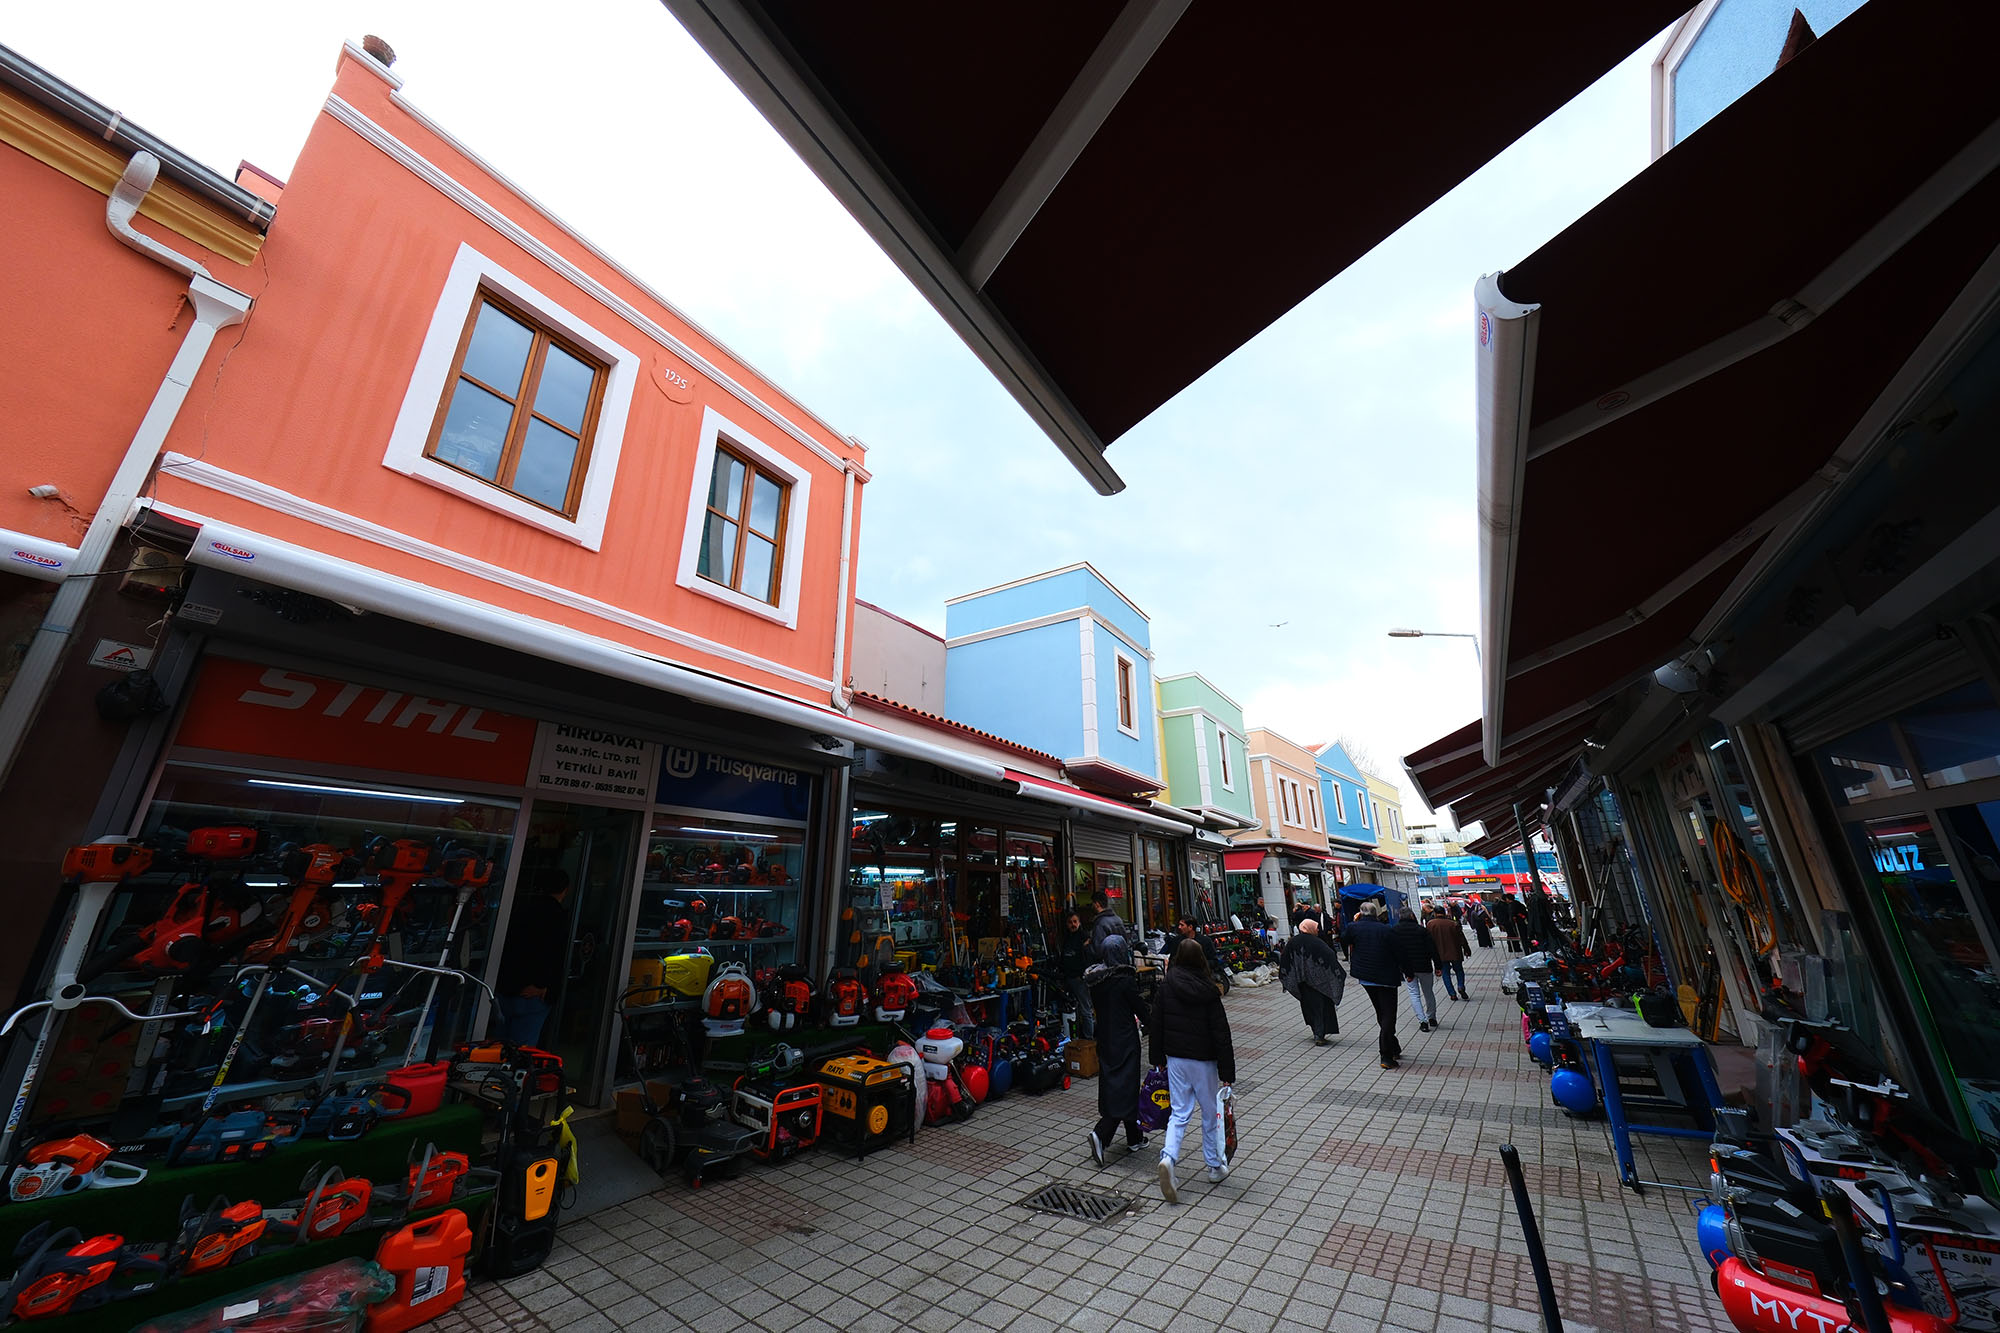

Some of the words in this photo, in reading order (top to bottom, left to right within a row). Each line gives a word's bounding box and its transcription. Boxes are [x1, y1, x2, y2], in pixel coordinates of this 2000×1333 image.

[665, 368, 688, 389] 1935
[214, 541, 250, 559] GÜLSAN
[16, 551, 57, 566] GÜLSAN
[555, 744, 578, 755] SAN
[706, 753, 798, 786] Husqvarna
[1869, 844, 1925, 873] VOLTZ
[826, 1064, 845, 1075] RATO
[119, 1144, 145, 1153] SENIX
[1962, 1253, 1992, 1266] SAW
